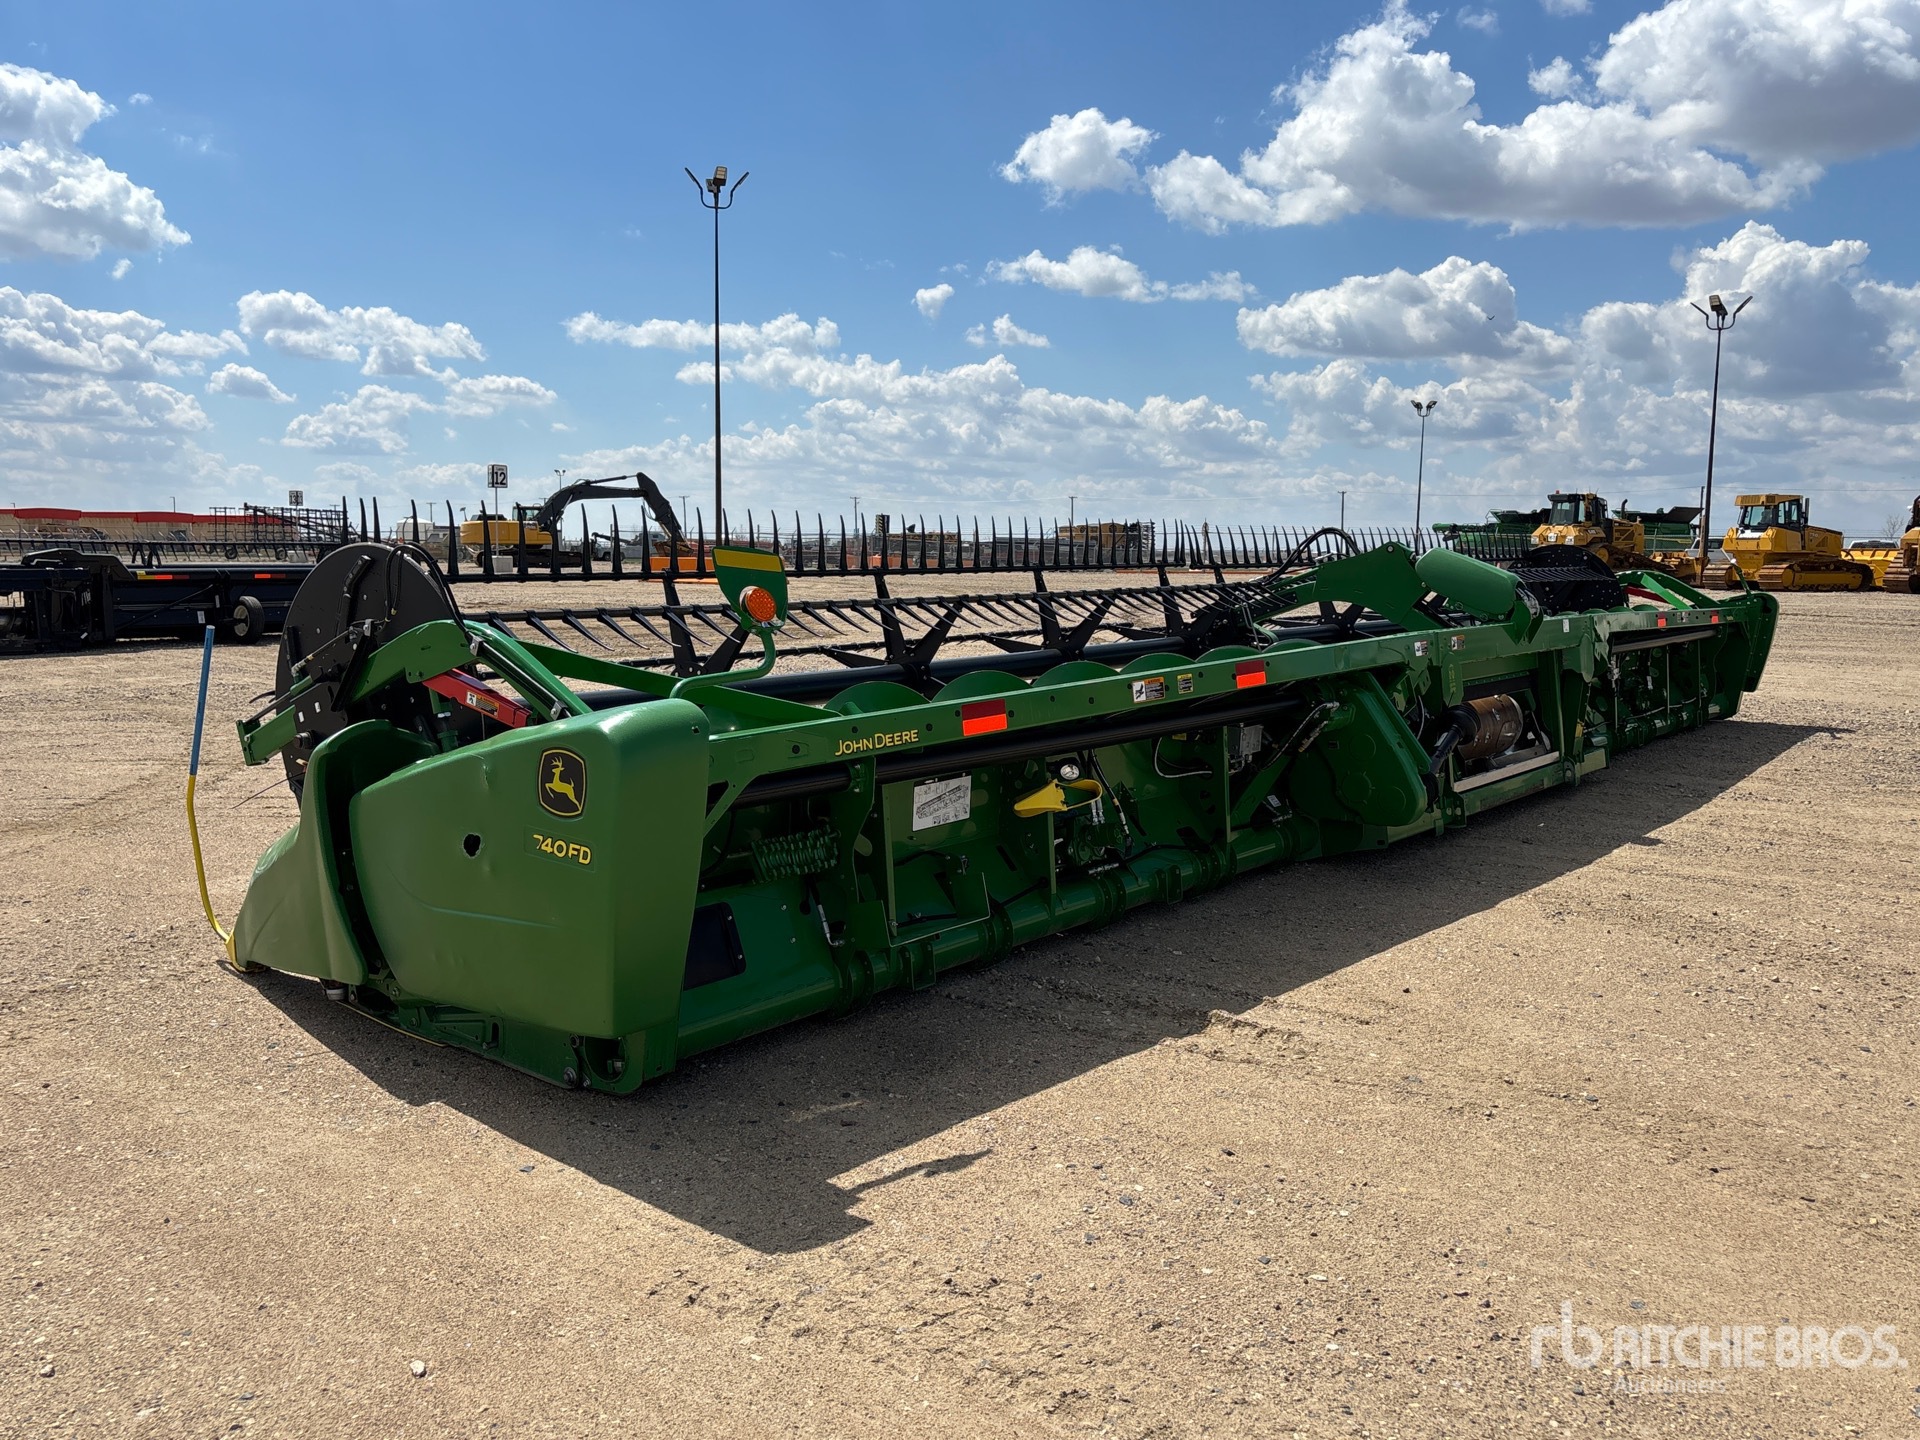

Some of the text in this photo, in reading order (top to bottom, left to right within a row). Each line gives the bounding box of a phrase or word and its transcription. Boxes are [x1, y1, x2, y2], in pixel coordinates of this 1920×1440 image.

[494, 471, 506, 485] 12
[835, 729, 919, 756] JOHN DEERE
[532, 834, 592, 865] 740FD
